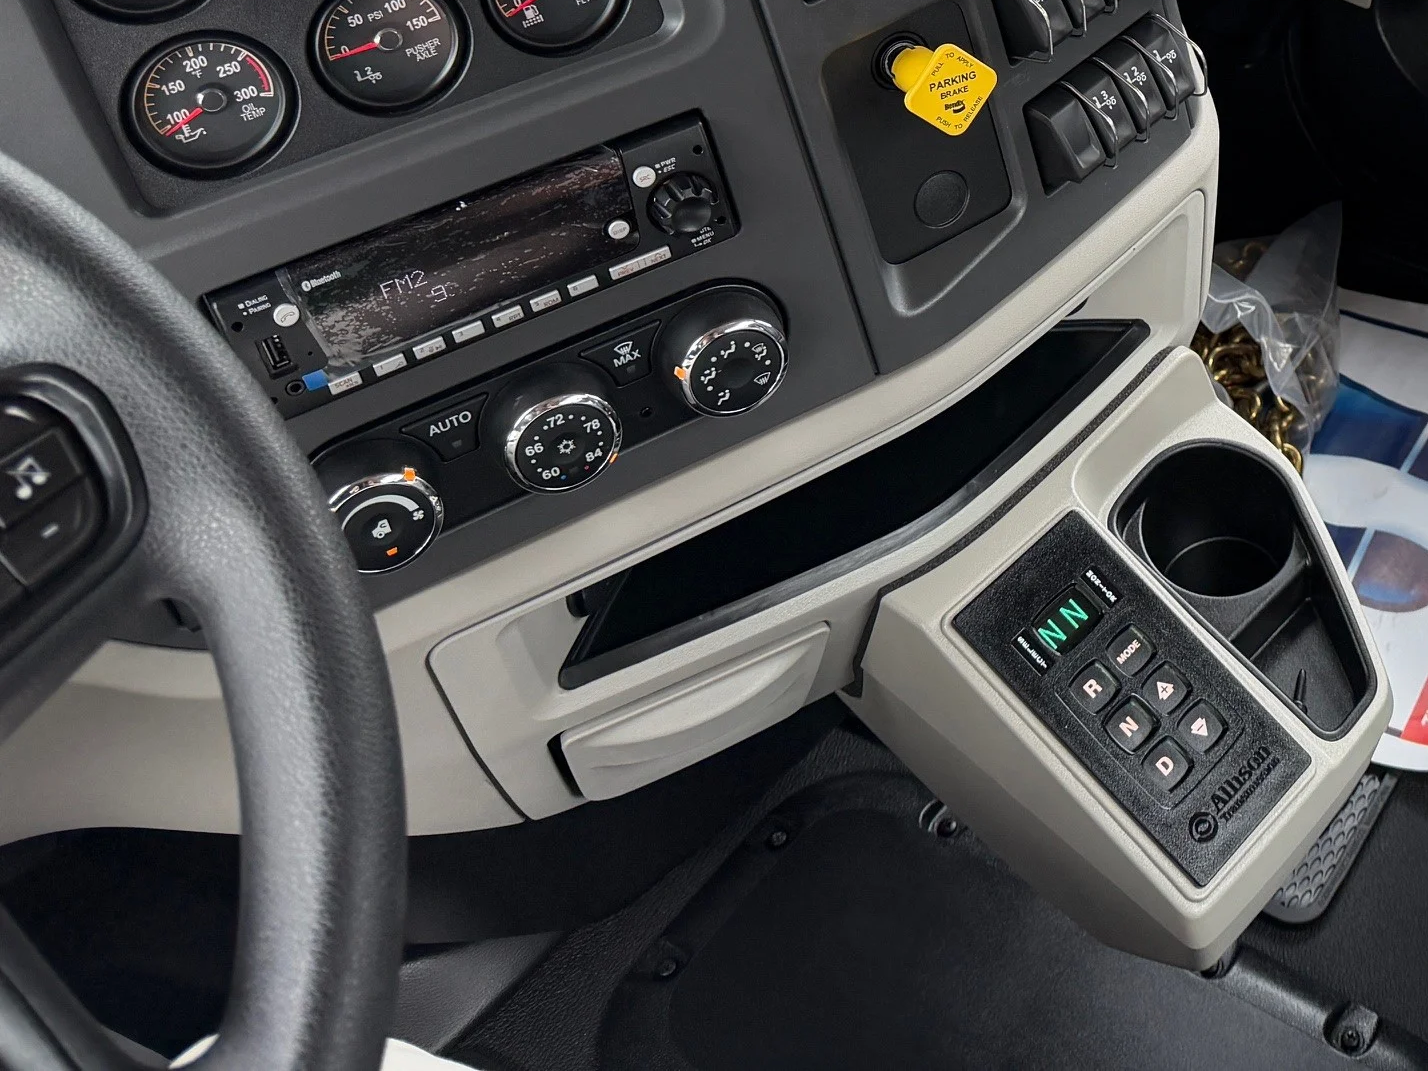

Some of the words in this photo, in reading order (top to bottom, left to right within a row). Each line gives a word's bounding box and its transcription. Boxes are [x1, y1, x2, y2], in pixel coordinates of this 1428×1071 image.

[347, 14, 363, 28] 50
[367, 10, 383, 22] PSI
[406, 15, 429, 31] 150
[405, 37, 441, 57] PUSHER
[416, 49, 438, 62] AXLE
[183, 55, 208, 73] 200
[216, 61, 241, 79] 250
[930, 61, 944, 77] PULL
[945, 52, 955, 60] TO
[956, 55, 974, 69] APPLY
[161, 79, 186, 96] 150
[929, 70, 977, 92] PARKING
[233, 85, 258, 103] 300
[940, 85, 969, 100] BRAKE
[166, 108, 190, 125] 100
[240, 107, 266, 122] TEMP
[241, 102, 257, 113] OIL
[935, 115, 951, 128] PUSH
[379, 270, 428, 300] FM2
[613, 349, 641, 368] MAX
[428, 409, 473, 438] AUTO
[547, 414, 565, 428] 72
[583, 419, 600, 433] 78
[525, 443, 544, 456] 66
[585, 448, 602, 462] 84
[542, 467, 560, 480] 60
[1085, 569, 1118, 603] MONITOR
[1017, 636, 1047, 668] SELECT
[1116, 639, 1141, 664] MODE
[1083, 678, 1103, 699] R
[1118, 715, 1139, 738] N
[1155, 756, 1174, 777] D
[1210, 745, 1271, 815] Allison
